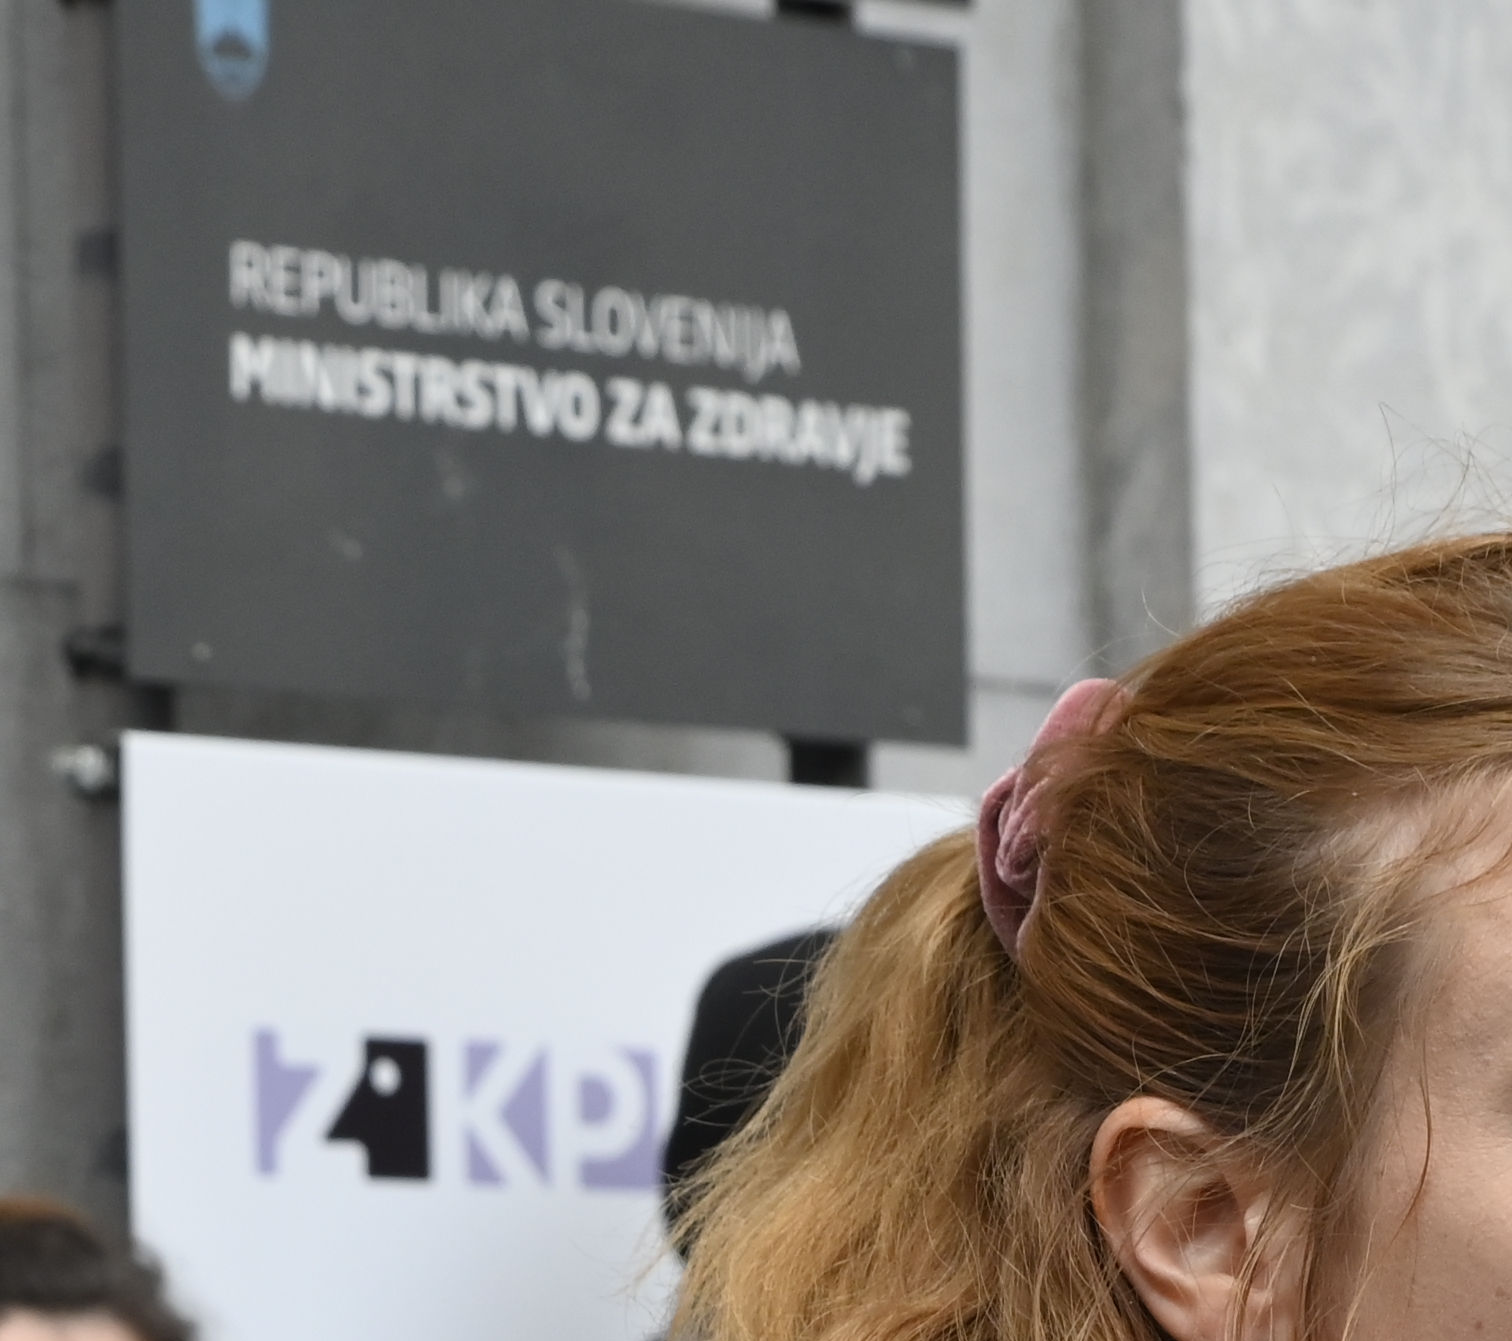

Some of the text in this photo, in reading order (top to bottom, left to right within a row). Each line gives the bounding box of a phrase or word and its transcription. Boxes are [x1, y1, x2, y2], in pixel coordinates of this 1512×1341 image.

[229, 239, 801, 384] REPUBLIKA SLOVENIJA
[229, 330, 912, 486] MINISTRSTVO ZA ZDRAVJE
